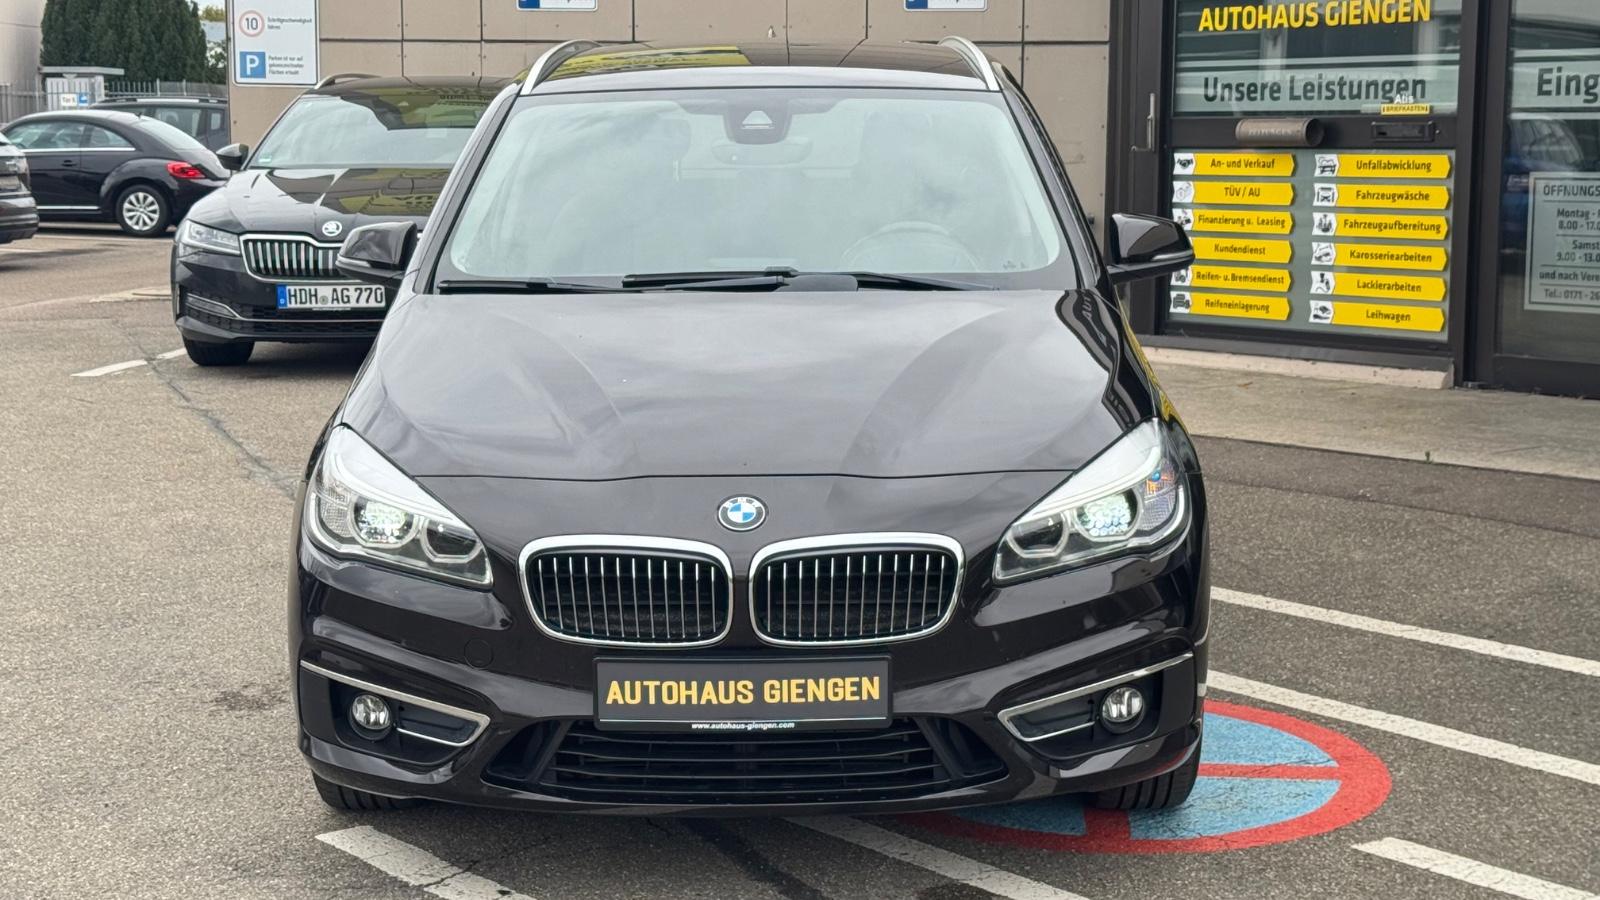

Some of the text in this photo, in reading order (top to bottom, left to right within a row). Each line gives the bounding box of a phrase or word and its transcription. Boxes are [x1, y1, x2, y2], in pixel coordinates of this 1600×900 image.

[1198, 0, 1431, 32] AUTOHAUS GIENGEN
[245, 17, 259, 30] 10
[246, 54, 260, 76] P
[1204, 73, 1427, 104] Unsere Leistungen
[1537, 66, 1600, 104] Eing
[1210, 158, 1275, 169] An- und Verkauf
[1356, 160, 1432, 173] Unfallabwicklung
[1224, 185, 1240, 196] TÜV
[1248, 187, 1261, 197] AU
[1355, 189, 1430, 202] Fahrzeugwäsche
[1556, 207, 1590, 220] Montag
[1198, 214, 1286, 229] Finanzierung u. Leasing
[1343, 218, 1441, 234] Fahrzeugaufbereitung
[1558, 220, 1578, 230] 8.00
[1214, 244, 1266, 255] Kundendienst
[1572, 239, 1600, 250] Samst
[1349, 249, 1432, 263] Karosseriearbeiten
[1556, 251, 1576, 262] 9.00
[1196, 271, 1285, 284] Reifen- u. Bremsendienst
[1539, 270, 1600, 282] und nach Vere
[1356, 279, 1421, 293] Lackierarbeiten
[288, 288, 318, 304] HDH
[331, 287, 350, 304] AG
[354, 287, 383, 304] 770
[1544, 287, 1562, 299] Tel.:
[1563, 289, 1583, 300] 0171
[1205, 299, 1270, 314] Reifeneinlagerung
[1366, 309, 1411, 323] Leihwagen
[606, 676, 880, 705] AUTOHAUS GIENGEN
[691, 721, 795, 731] www.autohaus-giengen.com
